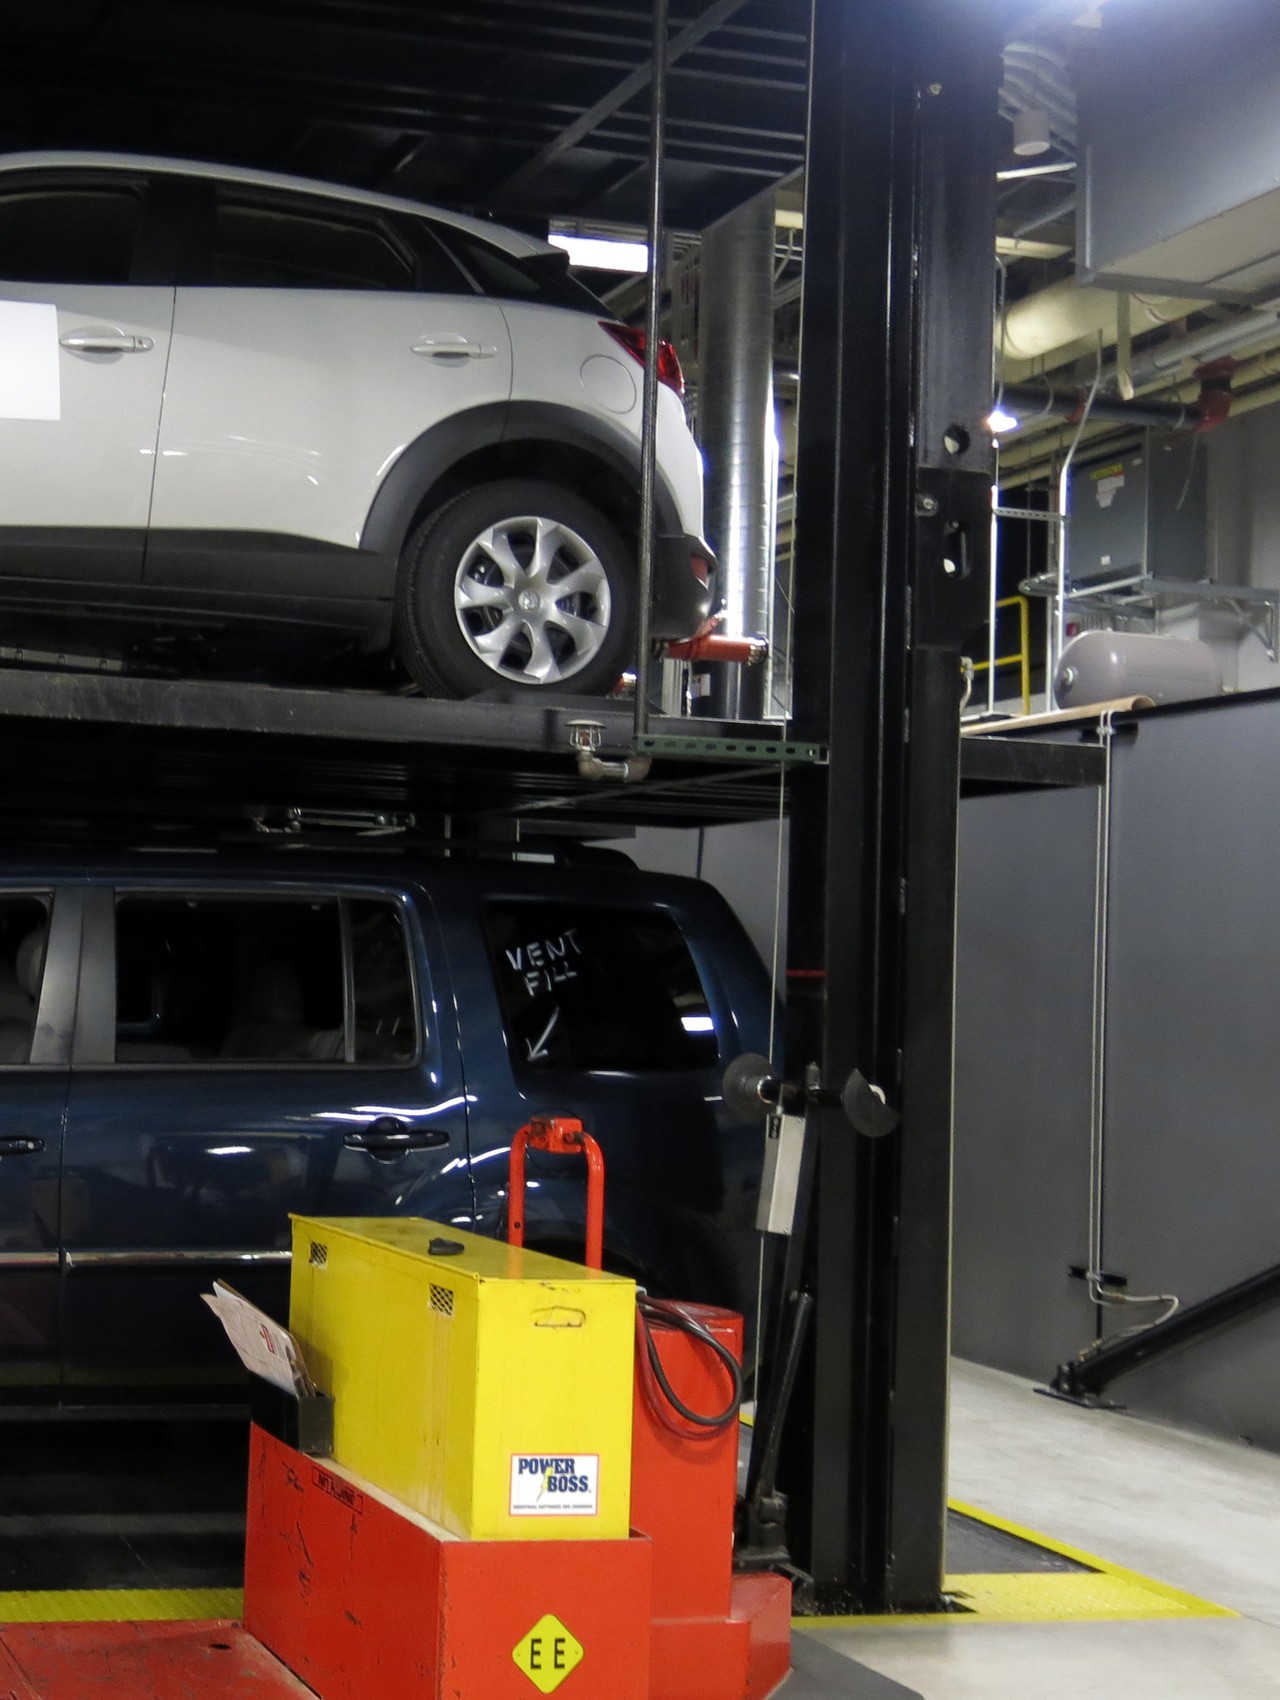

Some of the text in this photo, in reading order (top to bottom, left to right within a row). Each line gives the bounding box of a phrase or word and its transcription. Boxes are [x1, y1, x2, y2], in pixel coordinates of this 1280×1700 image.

[505, 928, 581, 970] VENT
[524, 961, 577, 997] FILL
[518, 1458, 575, 1475] POWER
[547, 1475, 589, 1493] BOSS
